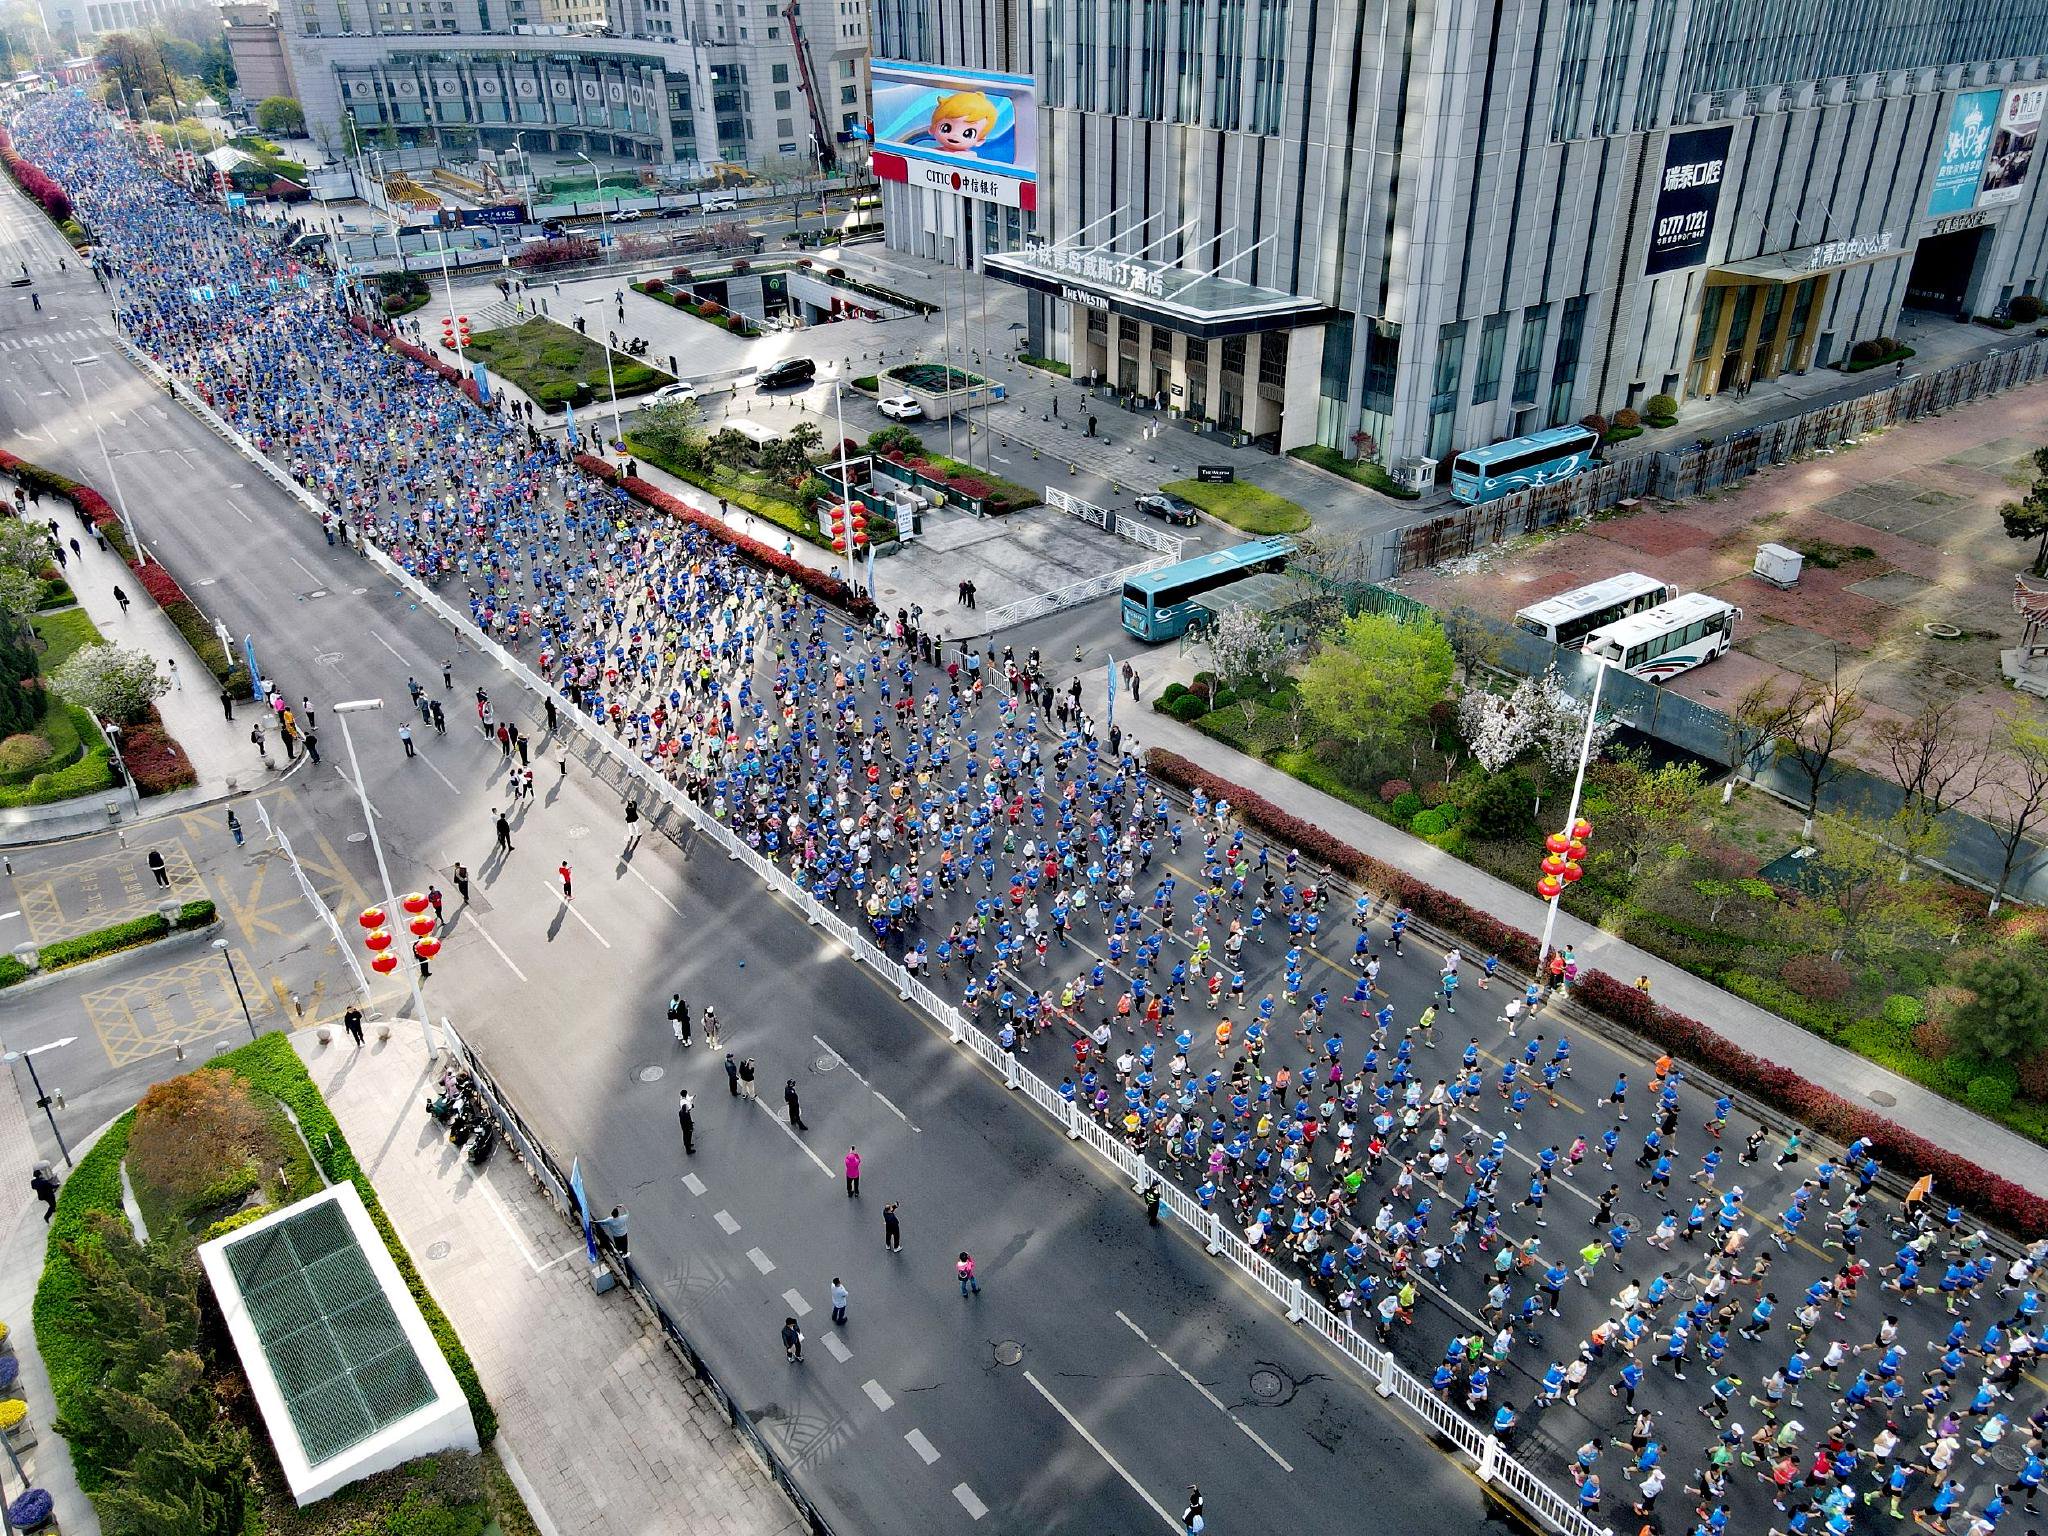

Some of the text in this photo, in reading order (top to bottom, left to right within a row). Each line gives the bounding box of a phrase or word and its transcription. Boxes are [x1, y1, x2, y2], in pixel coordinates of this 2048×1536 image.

[926, 169, 951, 186] CITIC
[962, 176, 999, 197] 中信银行
[1663, 160, 1723, 191] 瑞泰口腔
[1025, 240, 1164, 297] 中铁青岛威斯汀酒店
